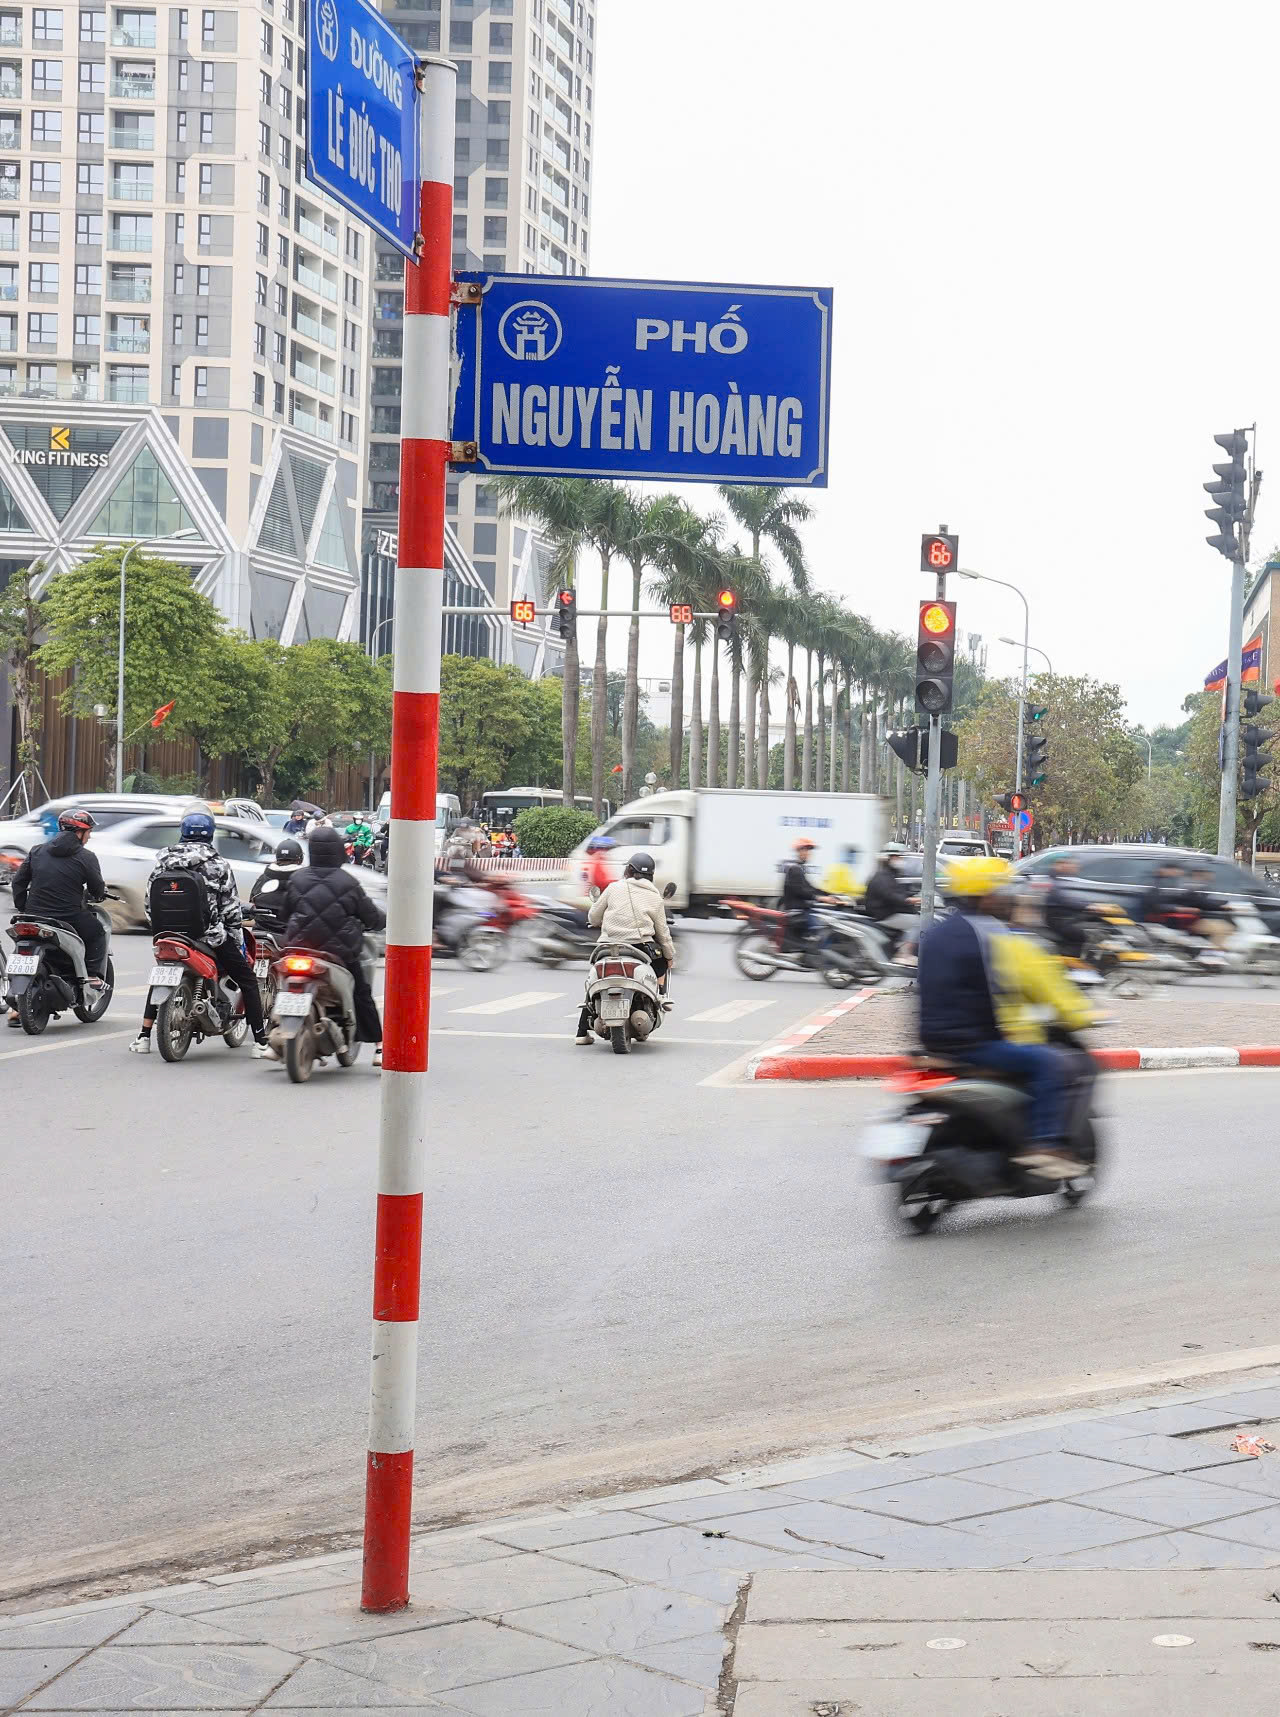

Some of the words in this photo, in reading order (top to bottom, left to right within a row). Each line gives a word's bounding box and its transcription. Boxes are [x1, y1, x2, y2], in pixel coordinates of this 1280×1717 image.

[351, 26, 402, 111] ĐƯỜNG
[327, 83, 345, 170] LÊ
[349, 102, 376, 193] ĐỨC
[380, 134, 401, 228] THỌ
[636, 304, 749, 355] PHỐ
[492, 365, 653, 452] NGUYỄN
[668, 382, 804, 458] HOÀNG
[10, 449, 46, 465] KING
[48, 451, 109, 468] FITNESS
[929, 541, 951, 568] 66
[515, 603, 533, 621] 66
